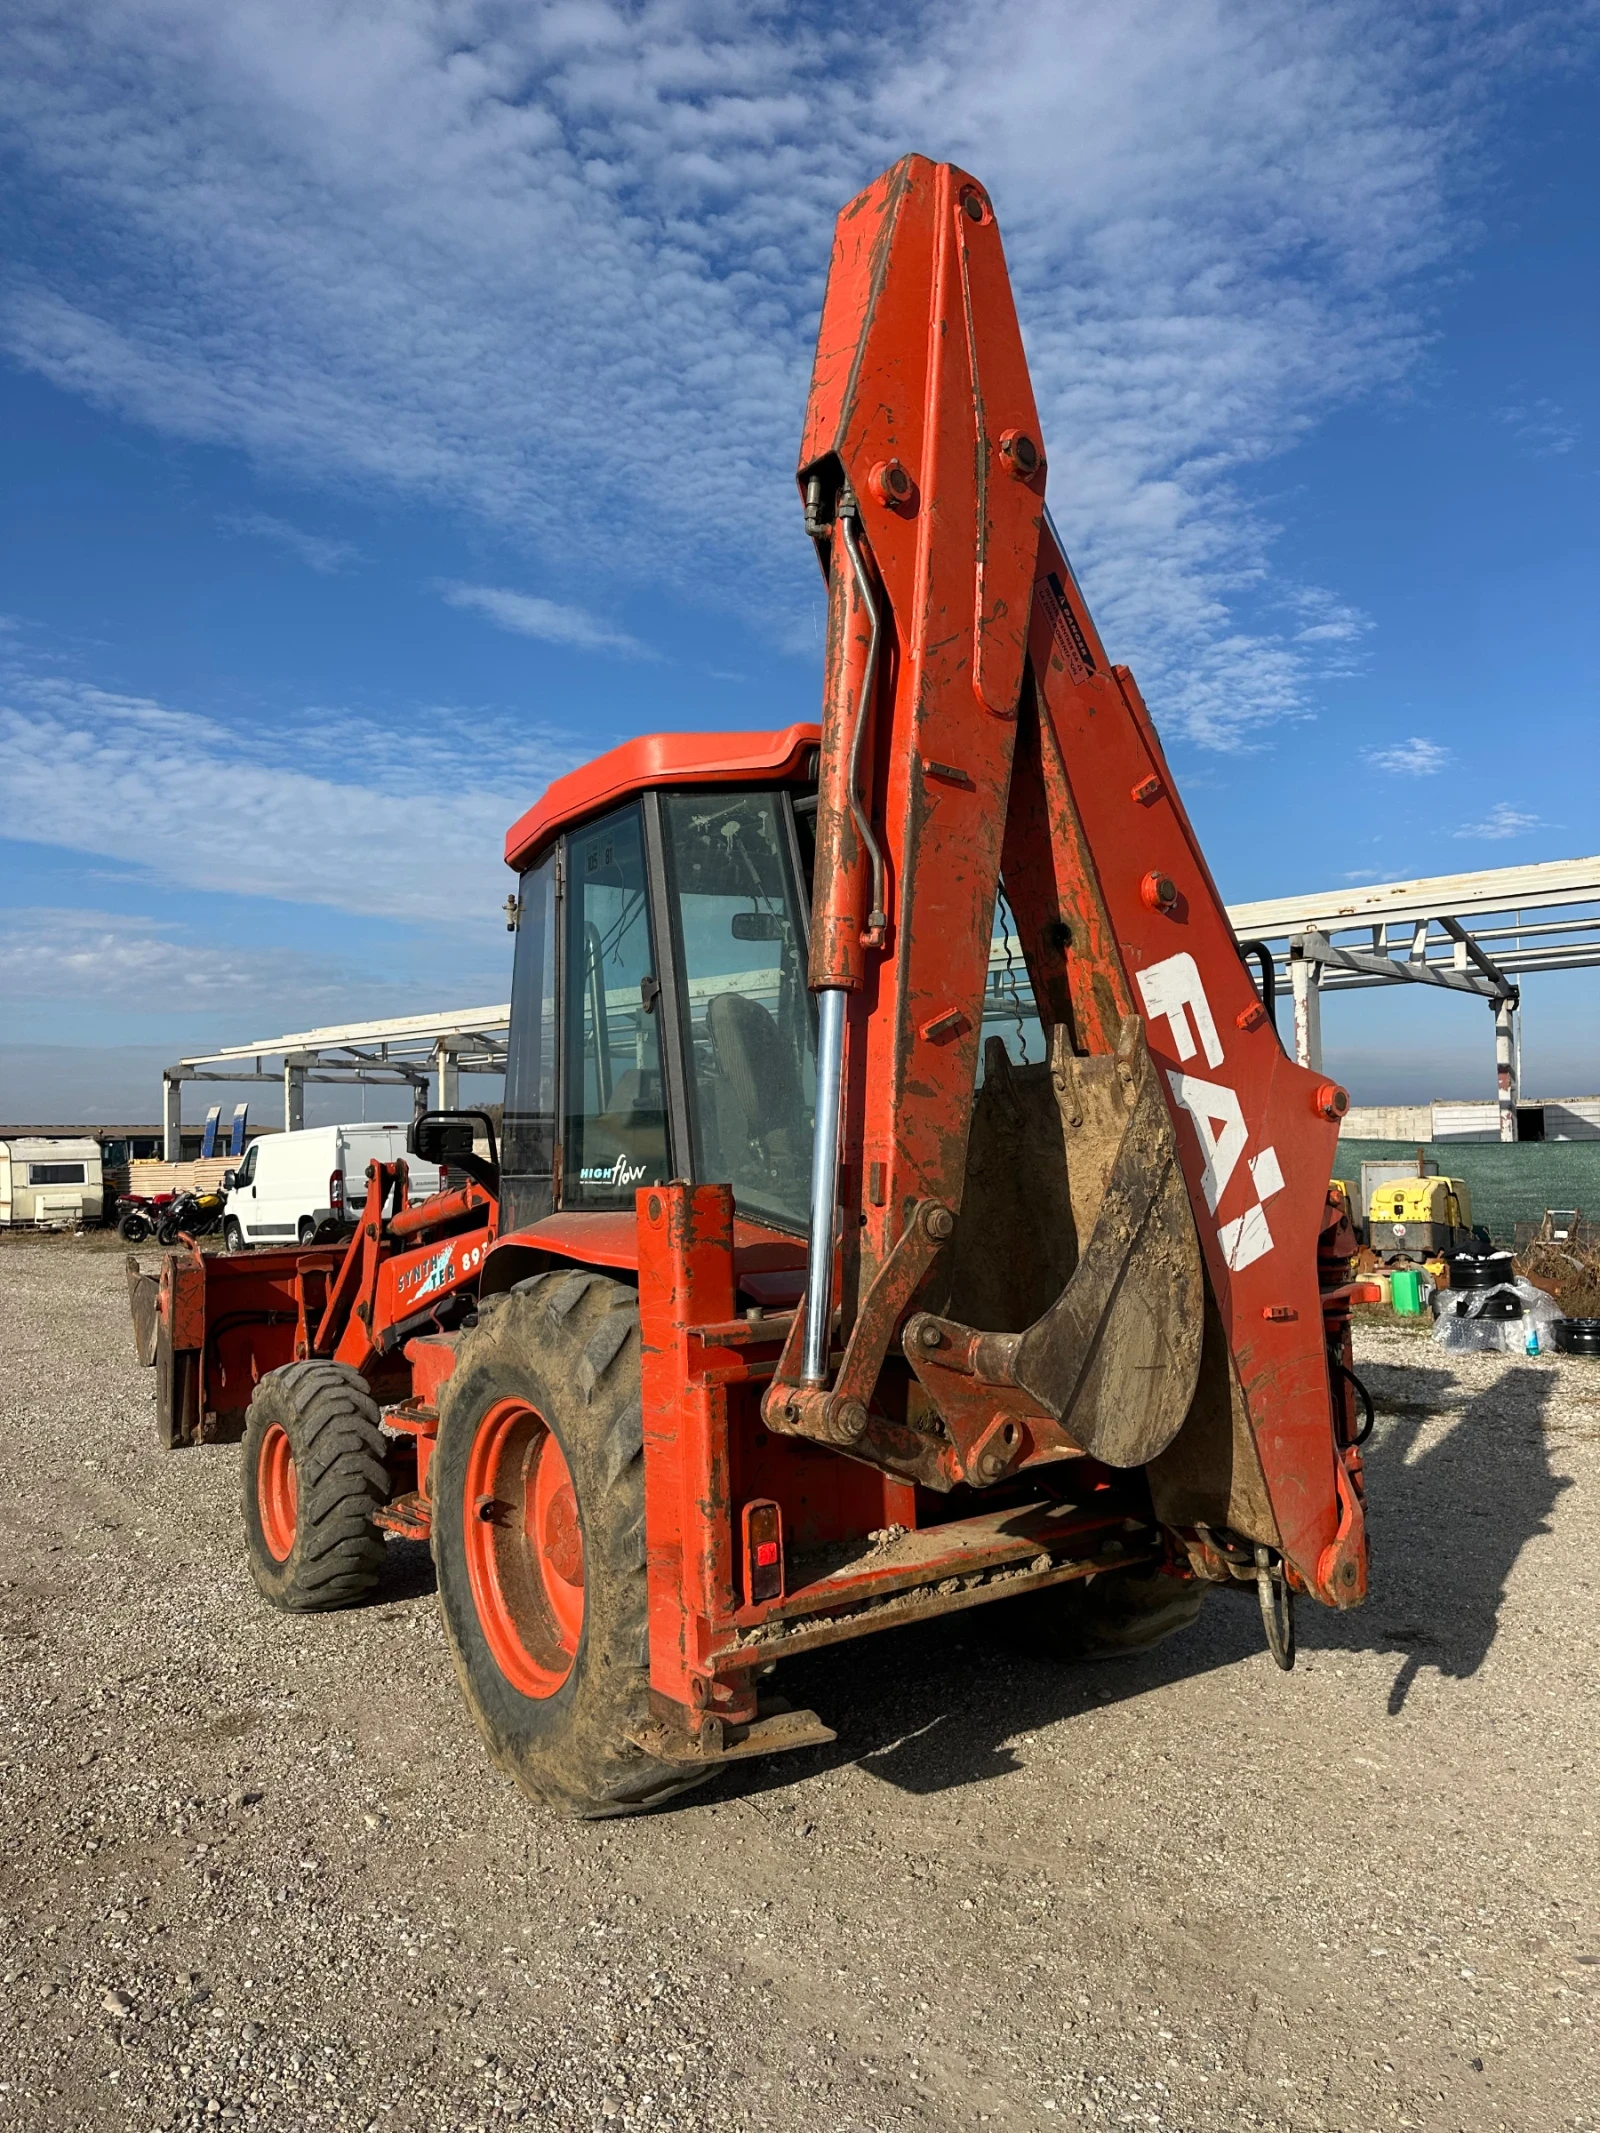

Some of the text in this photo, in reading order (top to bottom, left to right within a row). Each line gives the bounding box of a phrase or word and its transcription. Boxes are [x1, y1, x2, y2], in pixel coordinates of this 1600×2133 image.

[1053, 623, 1078, 675] D'ORIENTAON
[1063, 607, 1088, 656] DANGER
[431, 1264, 456, 1291] TER
